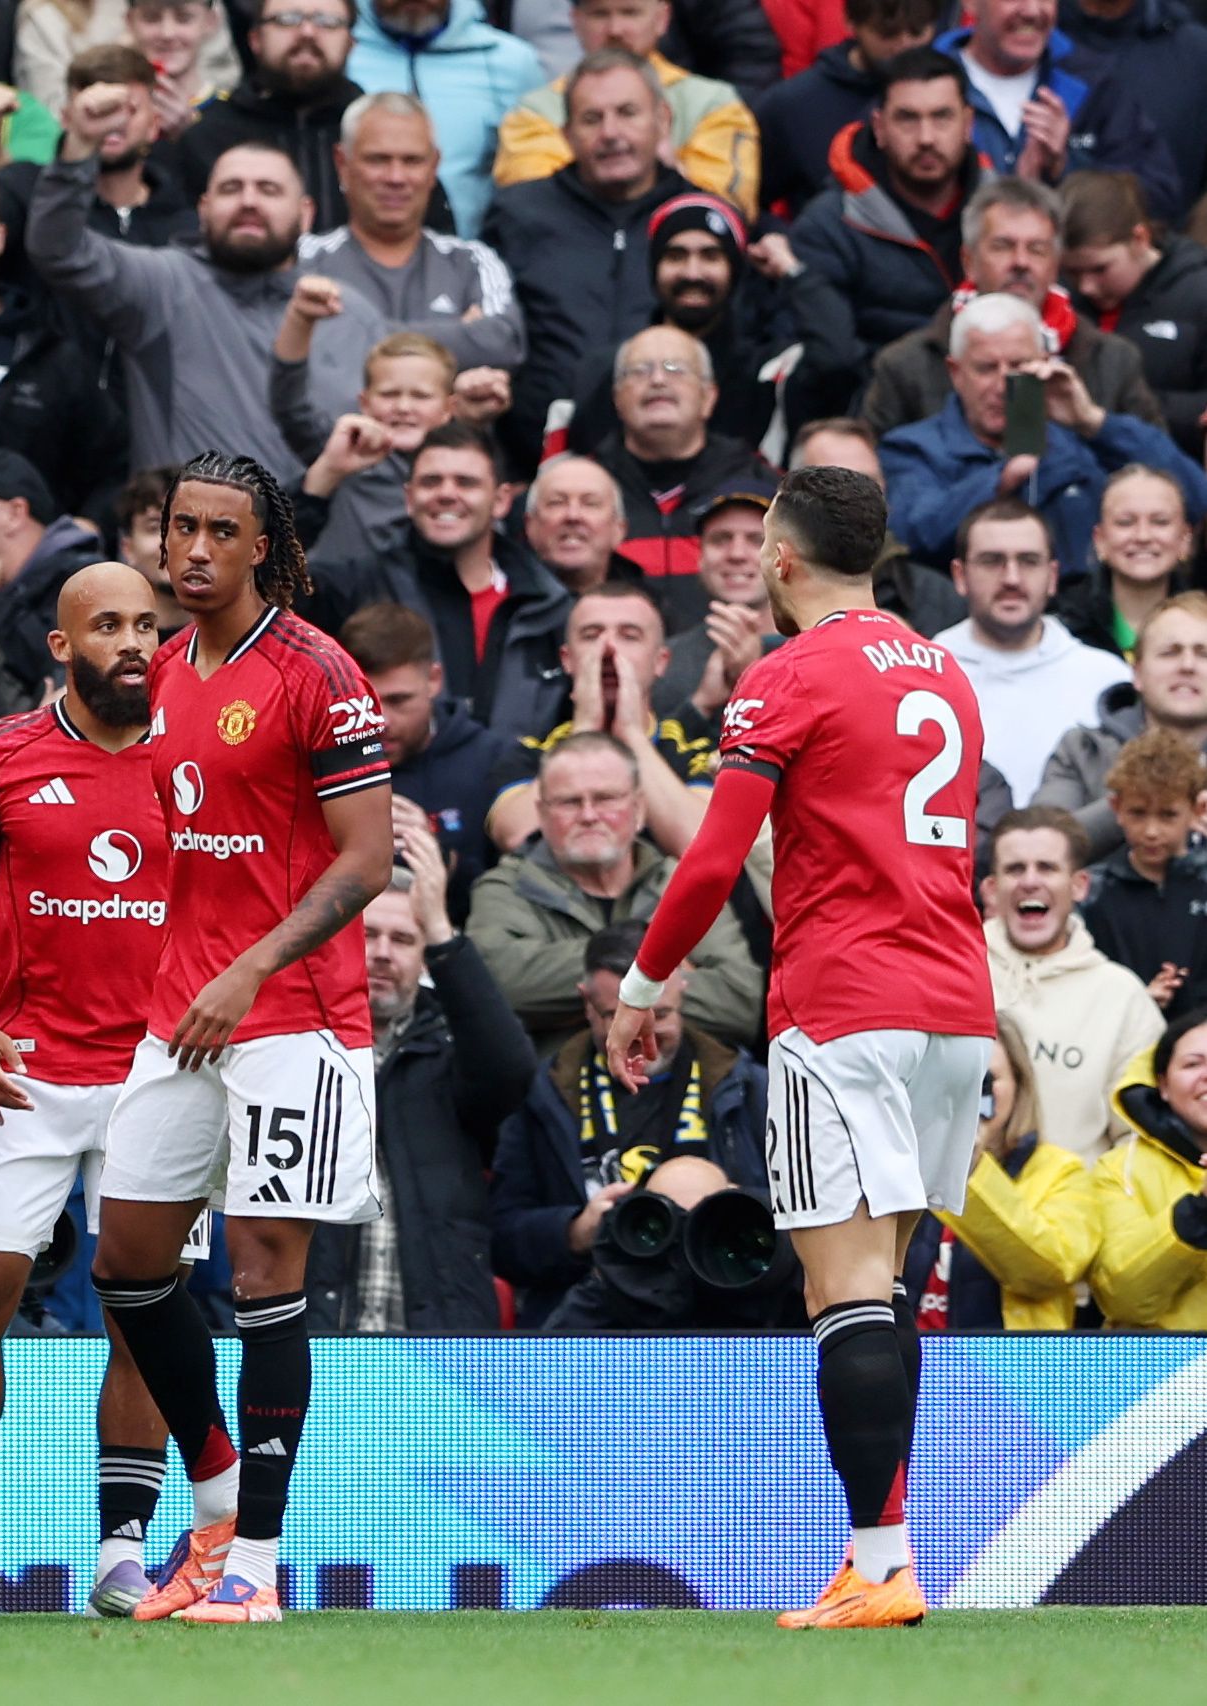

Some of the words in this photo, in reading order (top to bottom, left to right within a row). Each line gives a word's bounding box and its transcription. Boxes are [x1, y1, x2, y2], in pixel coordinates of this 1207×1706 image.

[862, 639, 945, 673] DALOT
[896, 690, 967, 848] 2
[246, 1104, 306, 1171] 15
